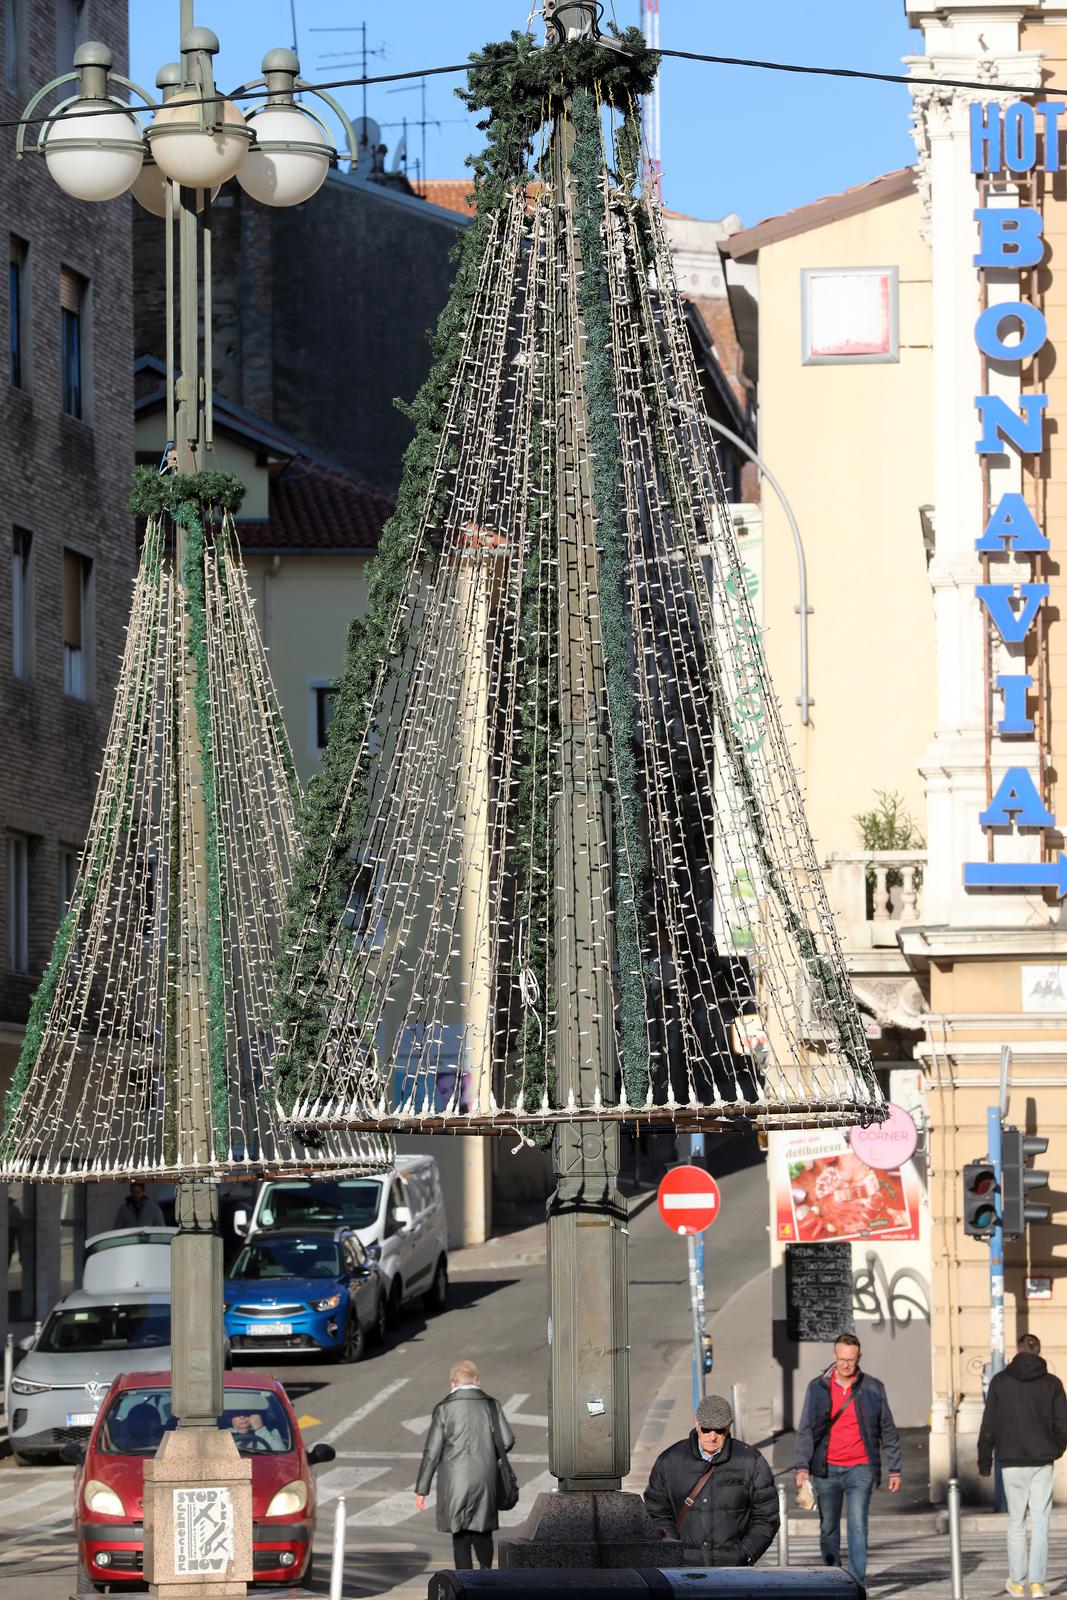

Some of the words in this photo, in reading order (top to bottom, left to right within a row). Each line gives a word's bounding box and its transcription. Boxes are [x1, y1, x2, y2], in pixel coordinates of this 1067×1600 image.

[972, 207, 1056, 827] BONAVIA
[858, 1131, 909, 1141] CORNER
[177, 1490, 218, 1503] STOP
[188, 1558, 224, 1571] NOW
